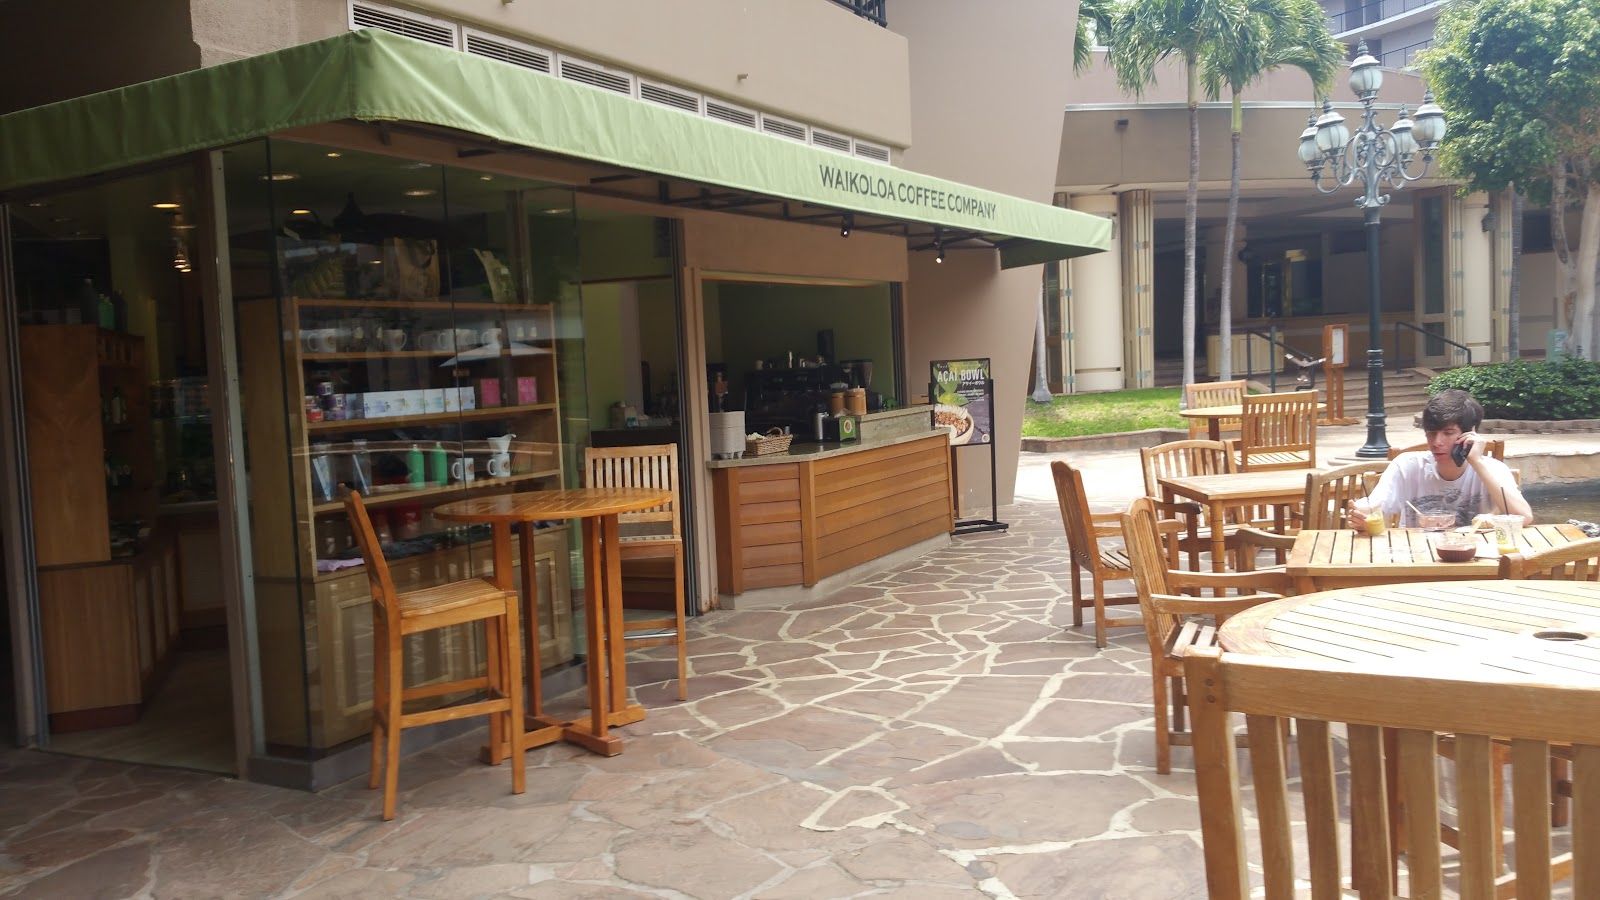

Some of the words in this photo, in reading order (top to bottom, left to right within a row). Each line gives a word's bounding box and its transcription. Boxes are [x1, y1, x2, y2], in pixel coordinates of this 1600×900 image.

[819, 164, 896, 201] WAIKOLOA
[897, 182, 945, 210] COFFEE
[947, 193, 996, 220] COMPANY
[961, 369, 985, 381] BOWL
